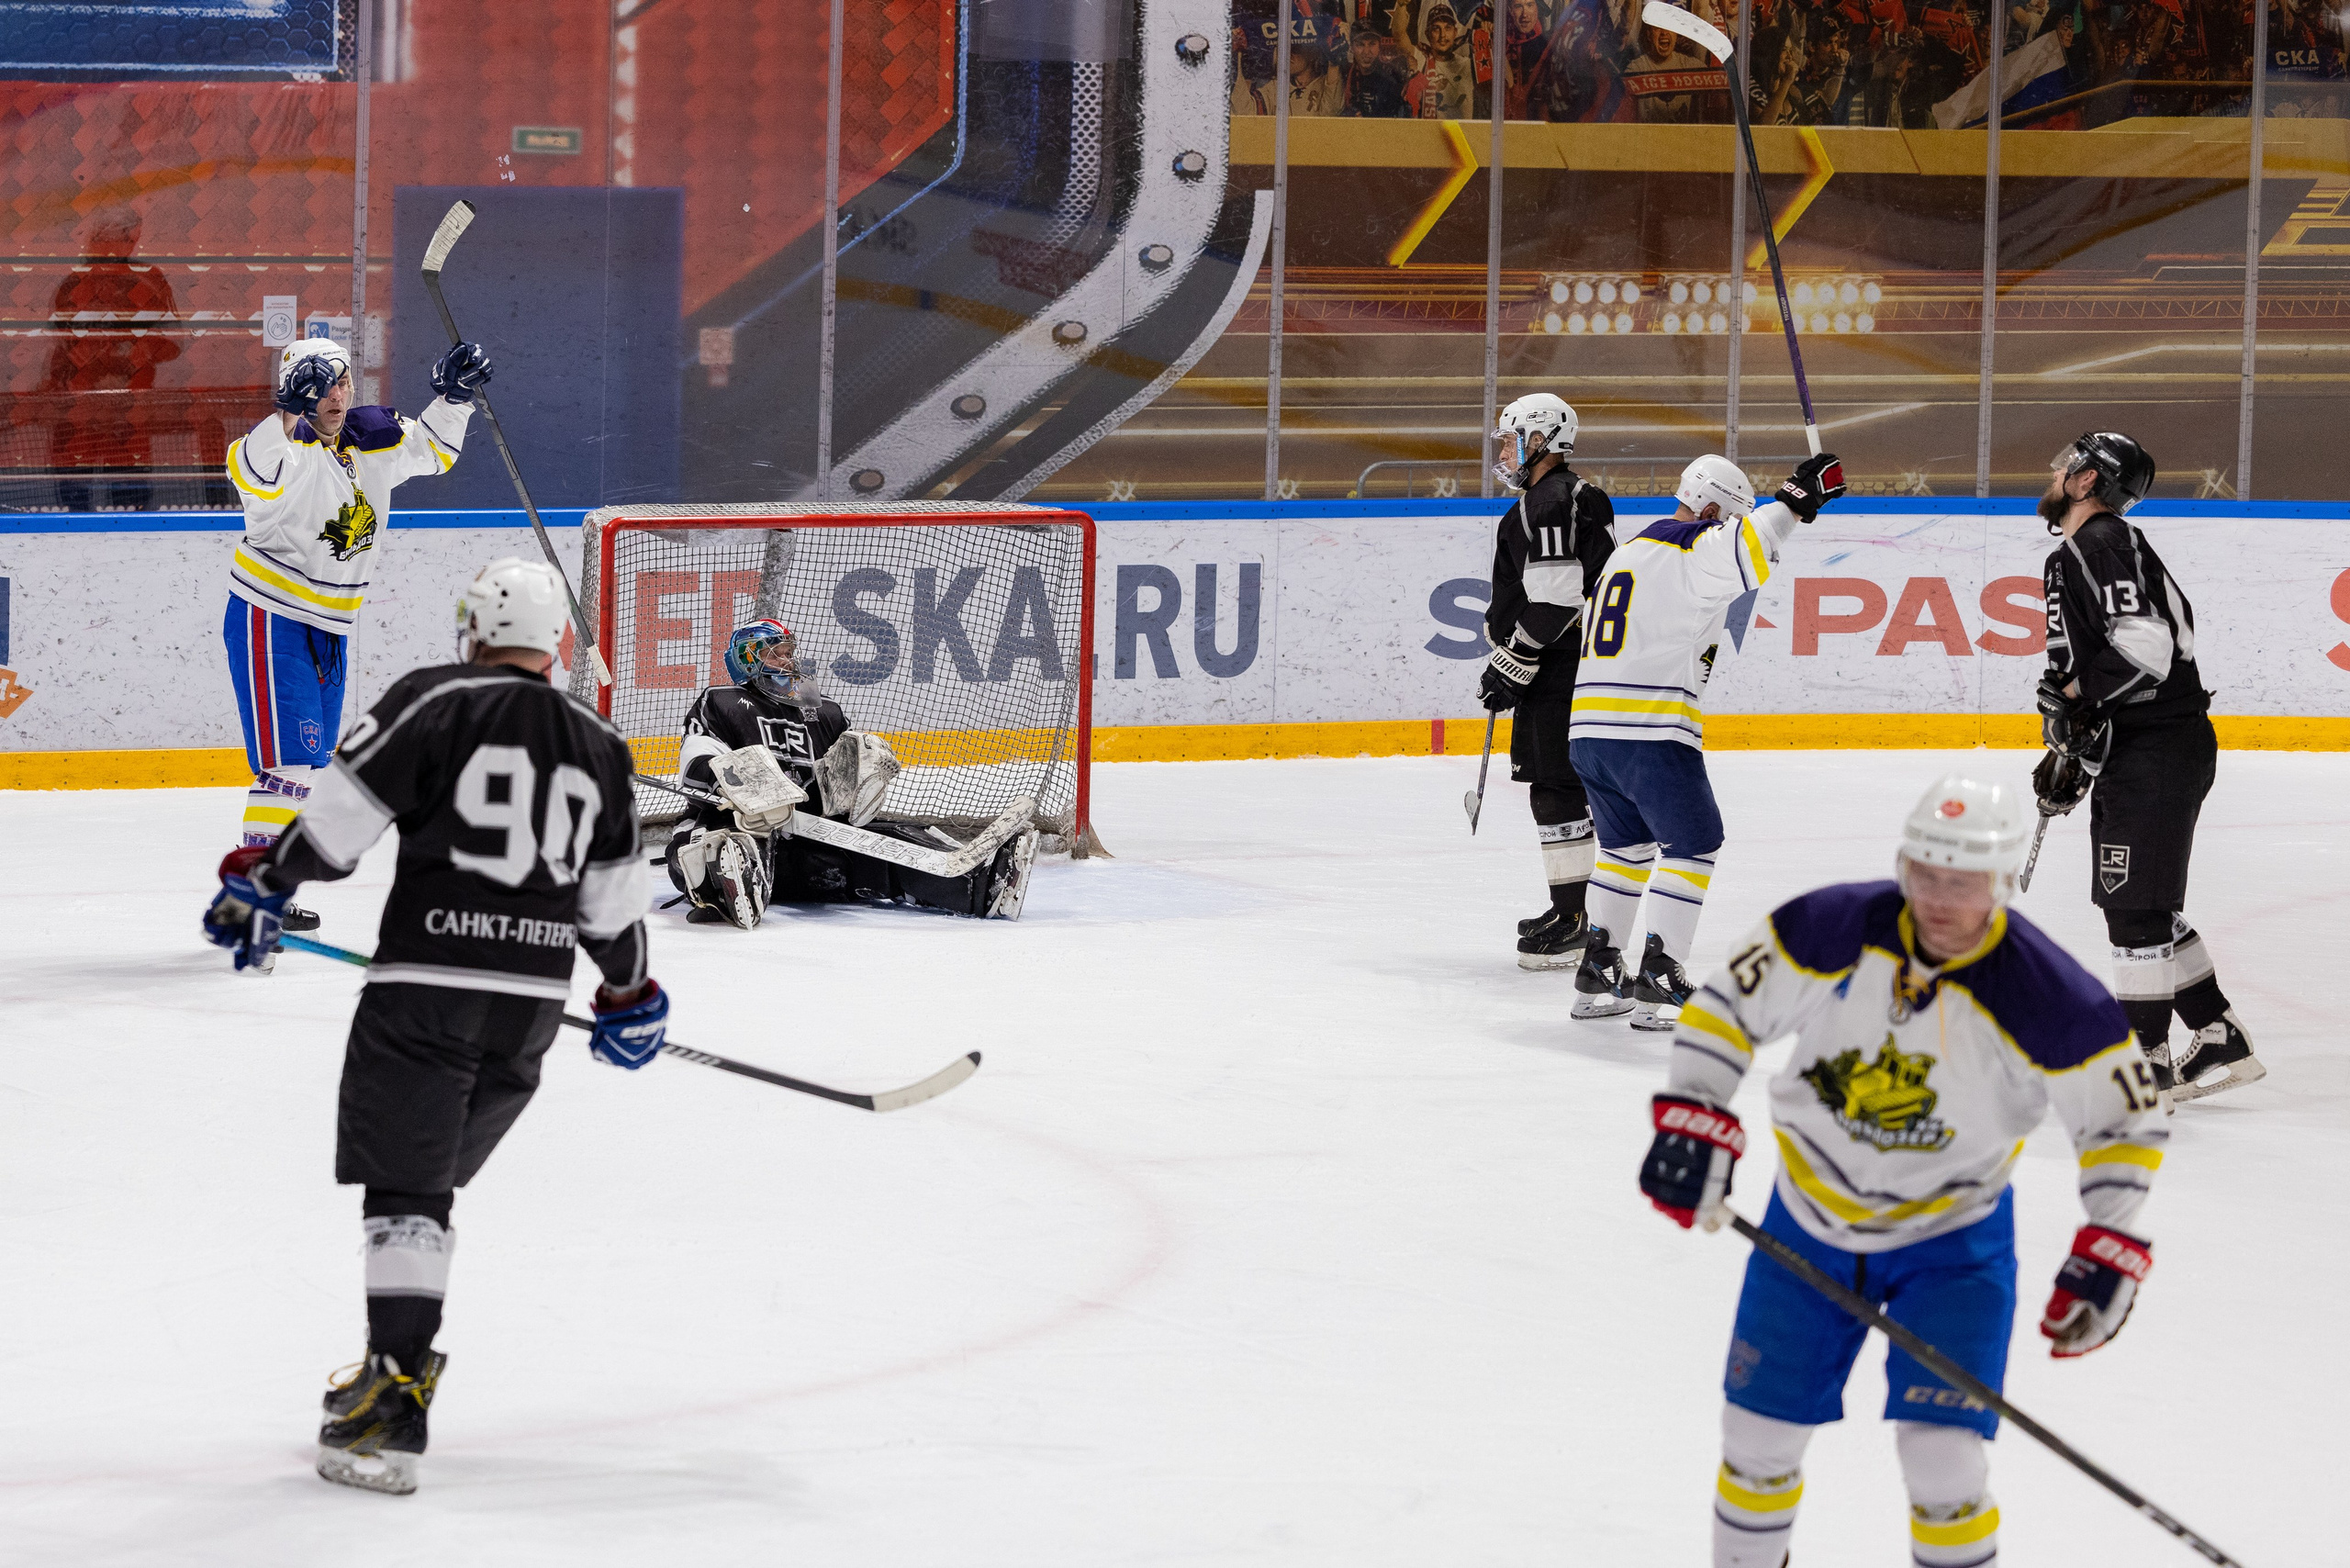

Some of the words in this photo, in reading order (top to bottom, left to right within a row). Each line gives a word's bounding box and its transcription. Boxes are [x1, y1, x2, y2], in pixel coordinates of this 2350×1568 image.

[2275, 50, 2320, 65] СКА
[1643, 76, 1668, 89] ICE
[1710, 481, 1733, 498] BAUER
[1539, 526, 1564, 557] 11
[2103, 579, 2140, 614] 13
[450, 743, 602, 888] 90
[806, 820, 927, 867] BAUER
[2101, 849, 2125, 866] LR
[424, 908, 577, 949] САНКТ-ПЕТЕРБ
[2110, 1060, 2157, 1113] 15
